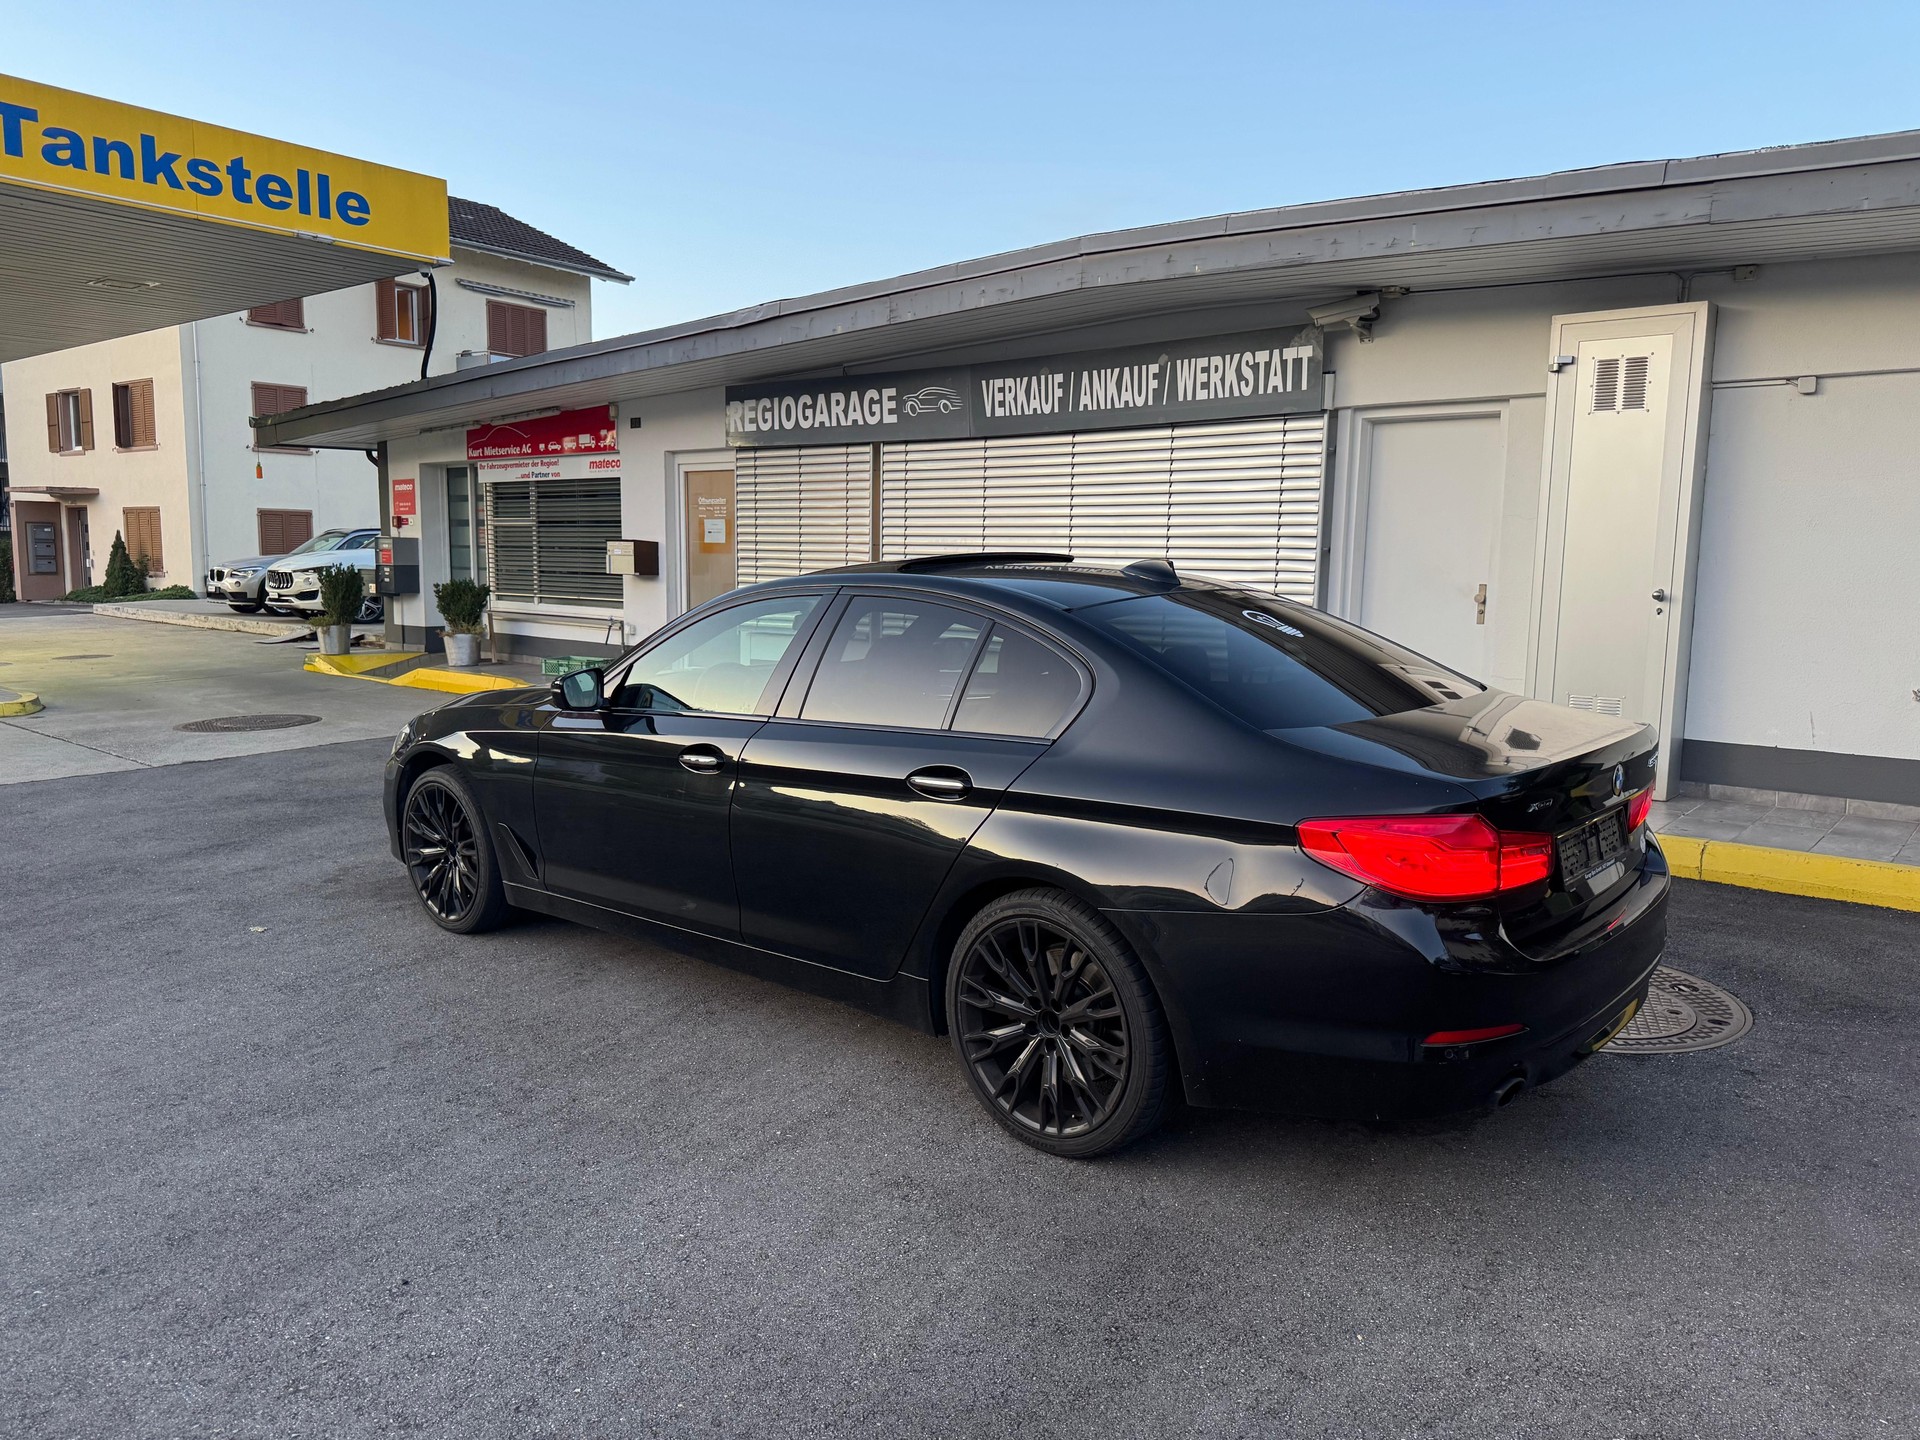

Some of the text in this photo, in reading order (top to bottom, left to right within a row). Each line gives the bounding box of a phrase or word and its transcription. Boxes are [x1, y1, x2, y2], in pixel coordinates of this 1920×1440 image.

[0, 102, 371, 226] Tankstelle
[981, 373, 1064, 417] VERKAUF
[1079, 363, 1160, 411] ANKAUF
[1176, 345, 1314, 402] WERKSTATT
[729, 388, 898, 433] REGIOGARAGE
[468, 443, 532, 457] Kurt Mietservice AG
[487, 461, 530, 471] Fahrzeugvermieter
[540, 458, 560, 468] Region!
[589, 458, 621, 470] mateco
